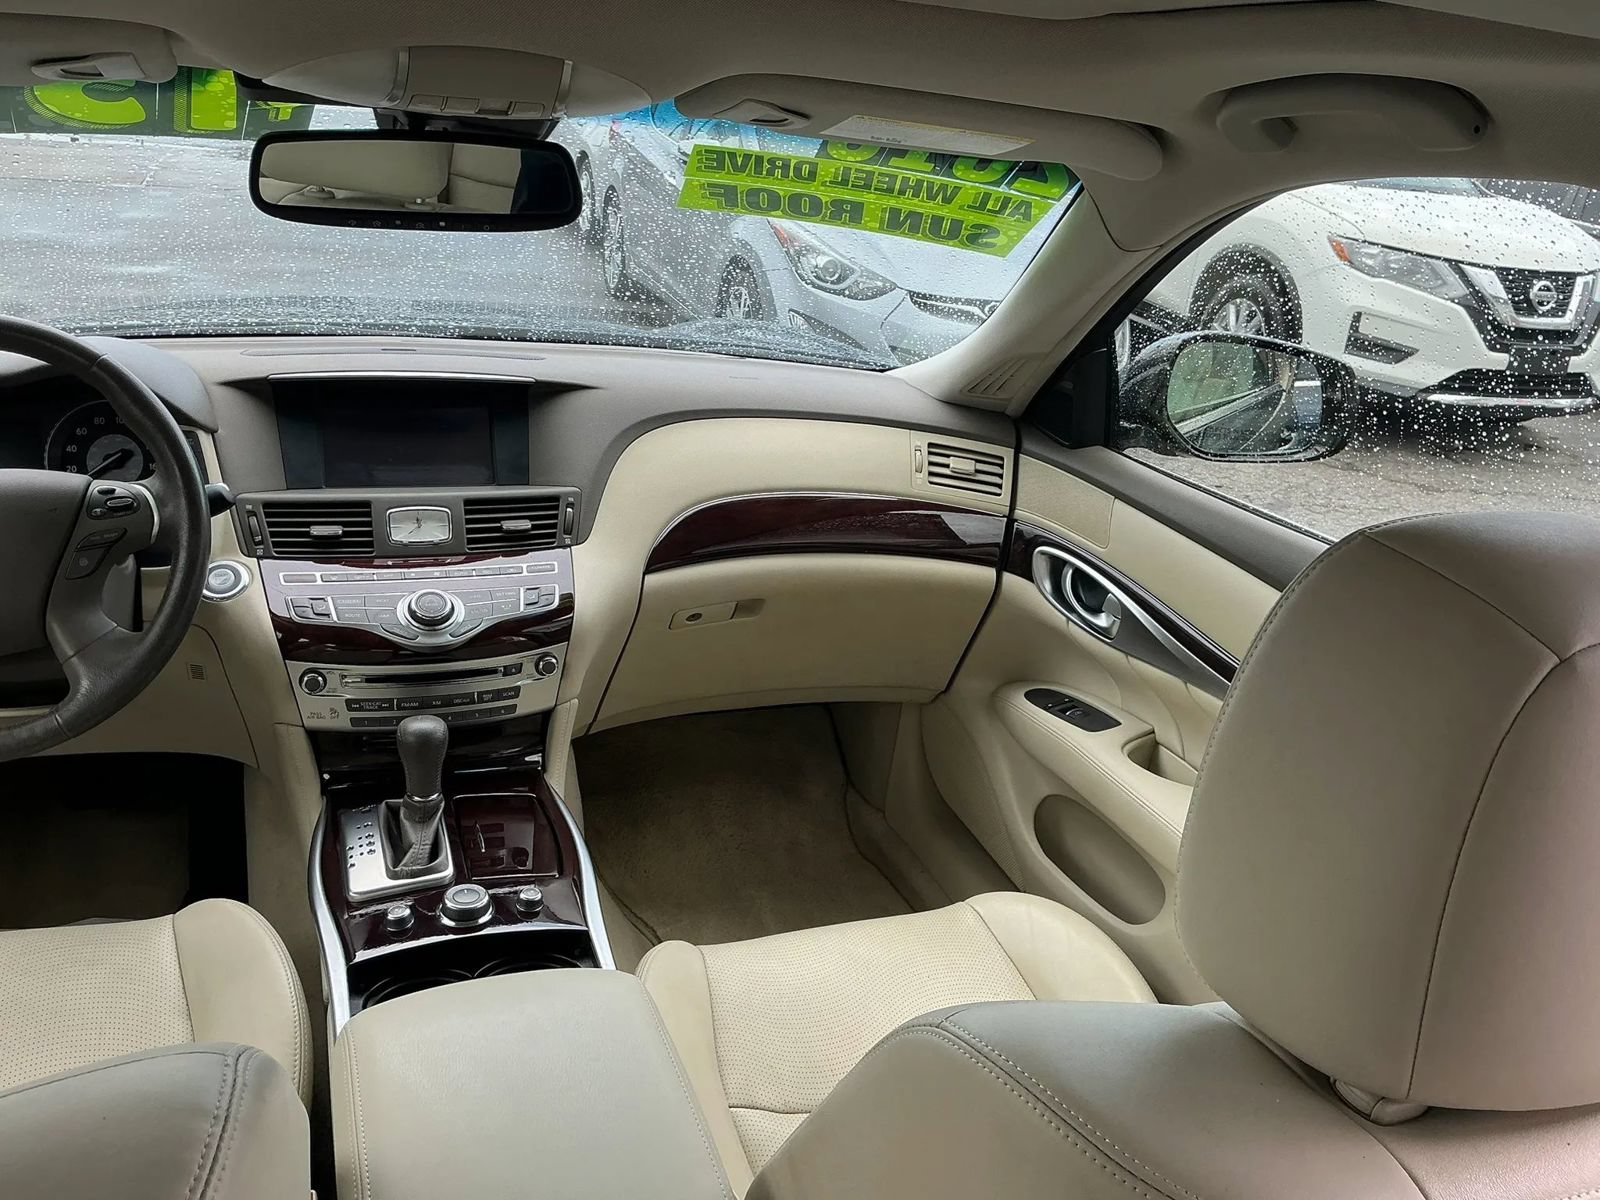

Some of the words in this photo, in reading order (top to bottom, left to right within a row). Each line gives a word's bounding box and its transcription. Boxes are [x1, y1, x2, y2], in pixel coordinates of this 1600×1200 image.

[94, 417, 105, 425] 80
[76, 427, 88, 436] 60
[66, 444, 78, 453] 40
[66, 465, 78, 473] 20
